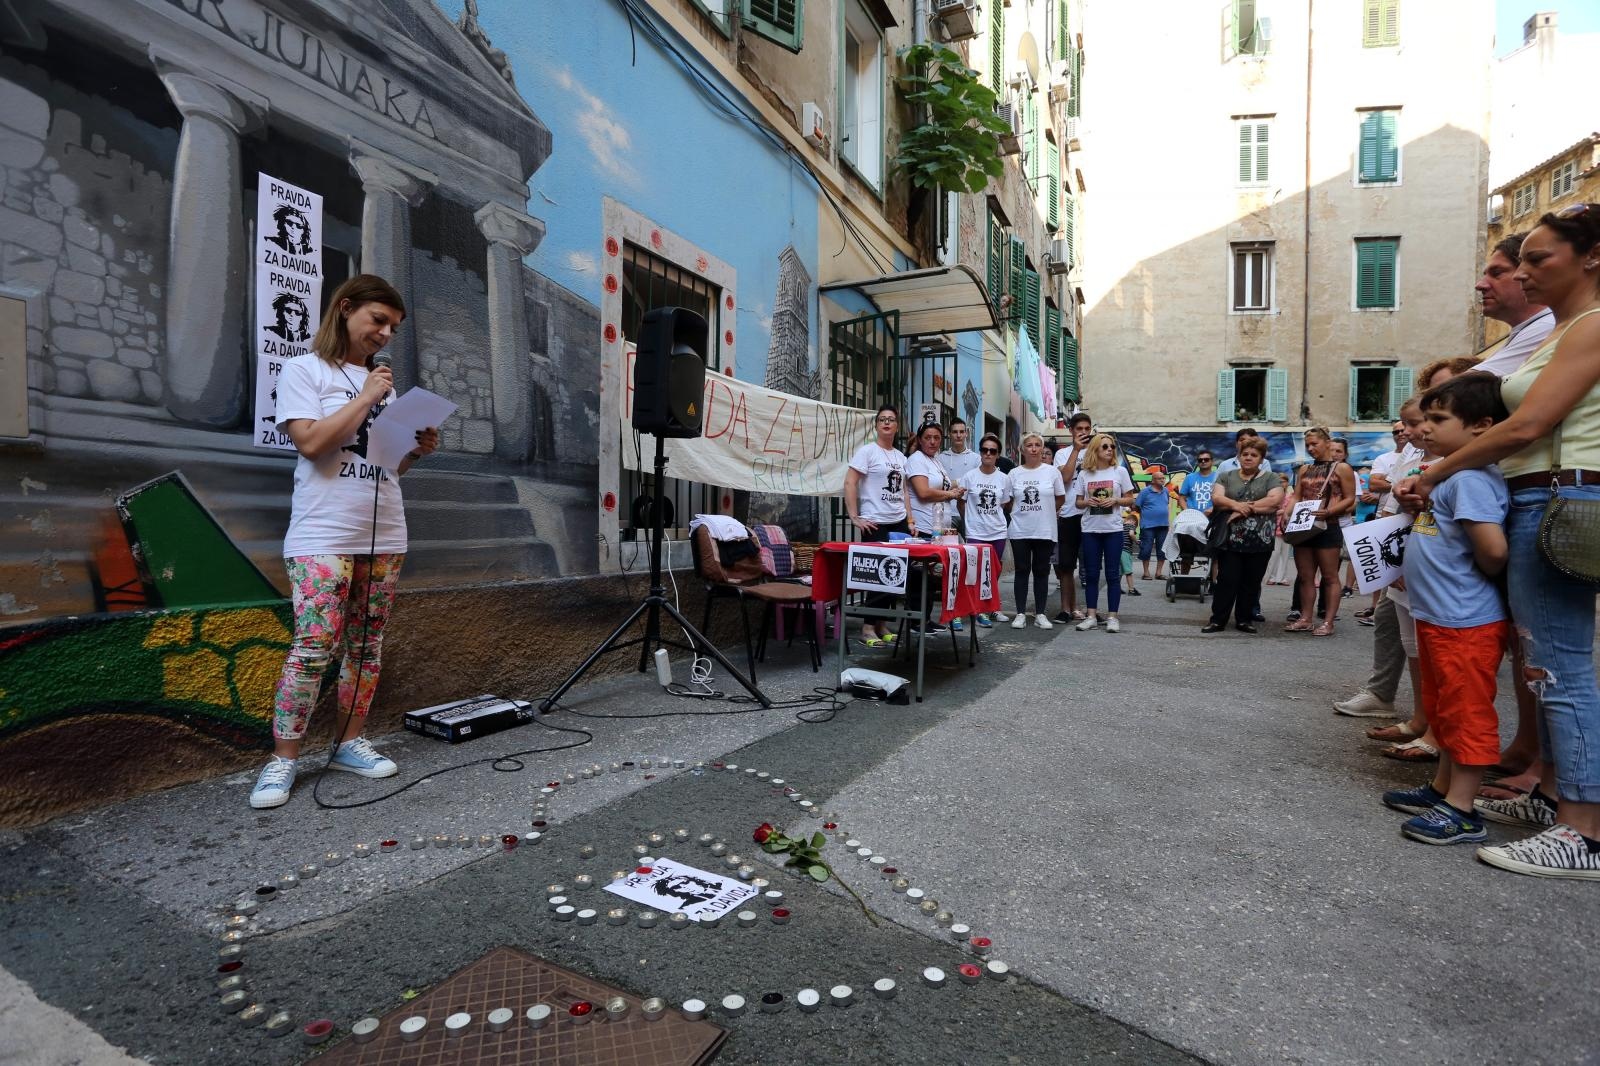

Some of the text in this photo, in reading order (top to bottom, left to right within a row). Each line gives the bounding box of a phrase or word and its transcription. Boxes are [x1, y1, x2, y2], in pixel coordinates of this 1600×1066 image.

[246, 11, 439, 141] JUNAKA
[270, 182, 312, 210] PRAVDA
[264, 249, 318, 277] ZA DAVIDA
[270, 271, 312, 296] PRAVDA
[263, 339, 310, 359] ZA DAVID
[262, 430, 277, 445] ZA
[763, 395, 806, 459] ZA
[339, 461, 357, 479] ZA
[751, 457, 833, 493] RIJEKA
[1195, 491, 1211, 501] DO
[1197, 500, 1209, 510] IT
[852, 556, 879, 569] RIJEKA
[1353, 535, 1381, 583] PRAVDA
[710, 886, 755, 910] DAVIDA
